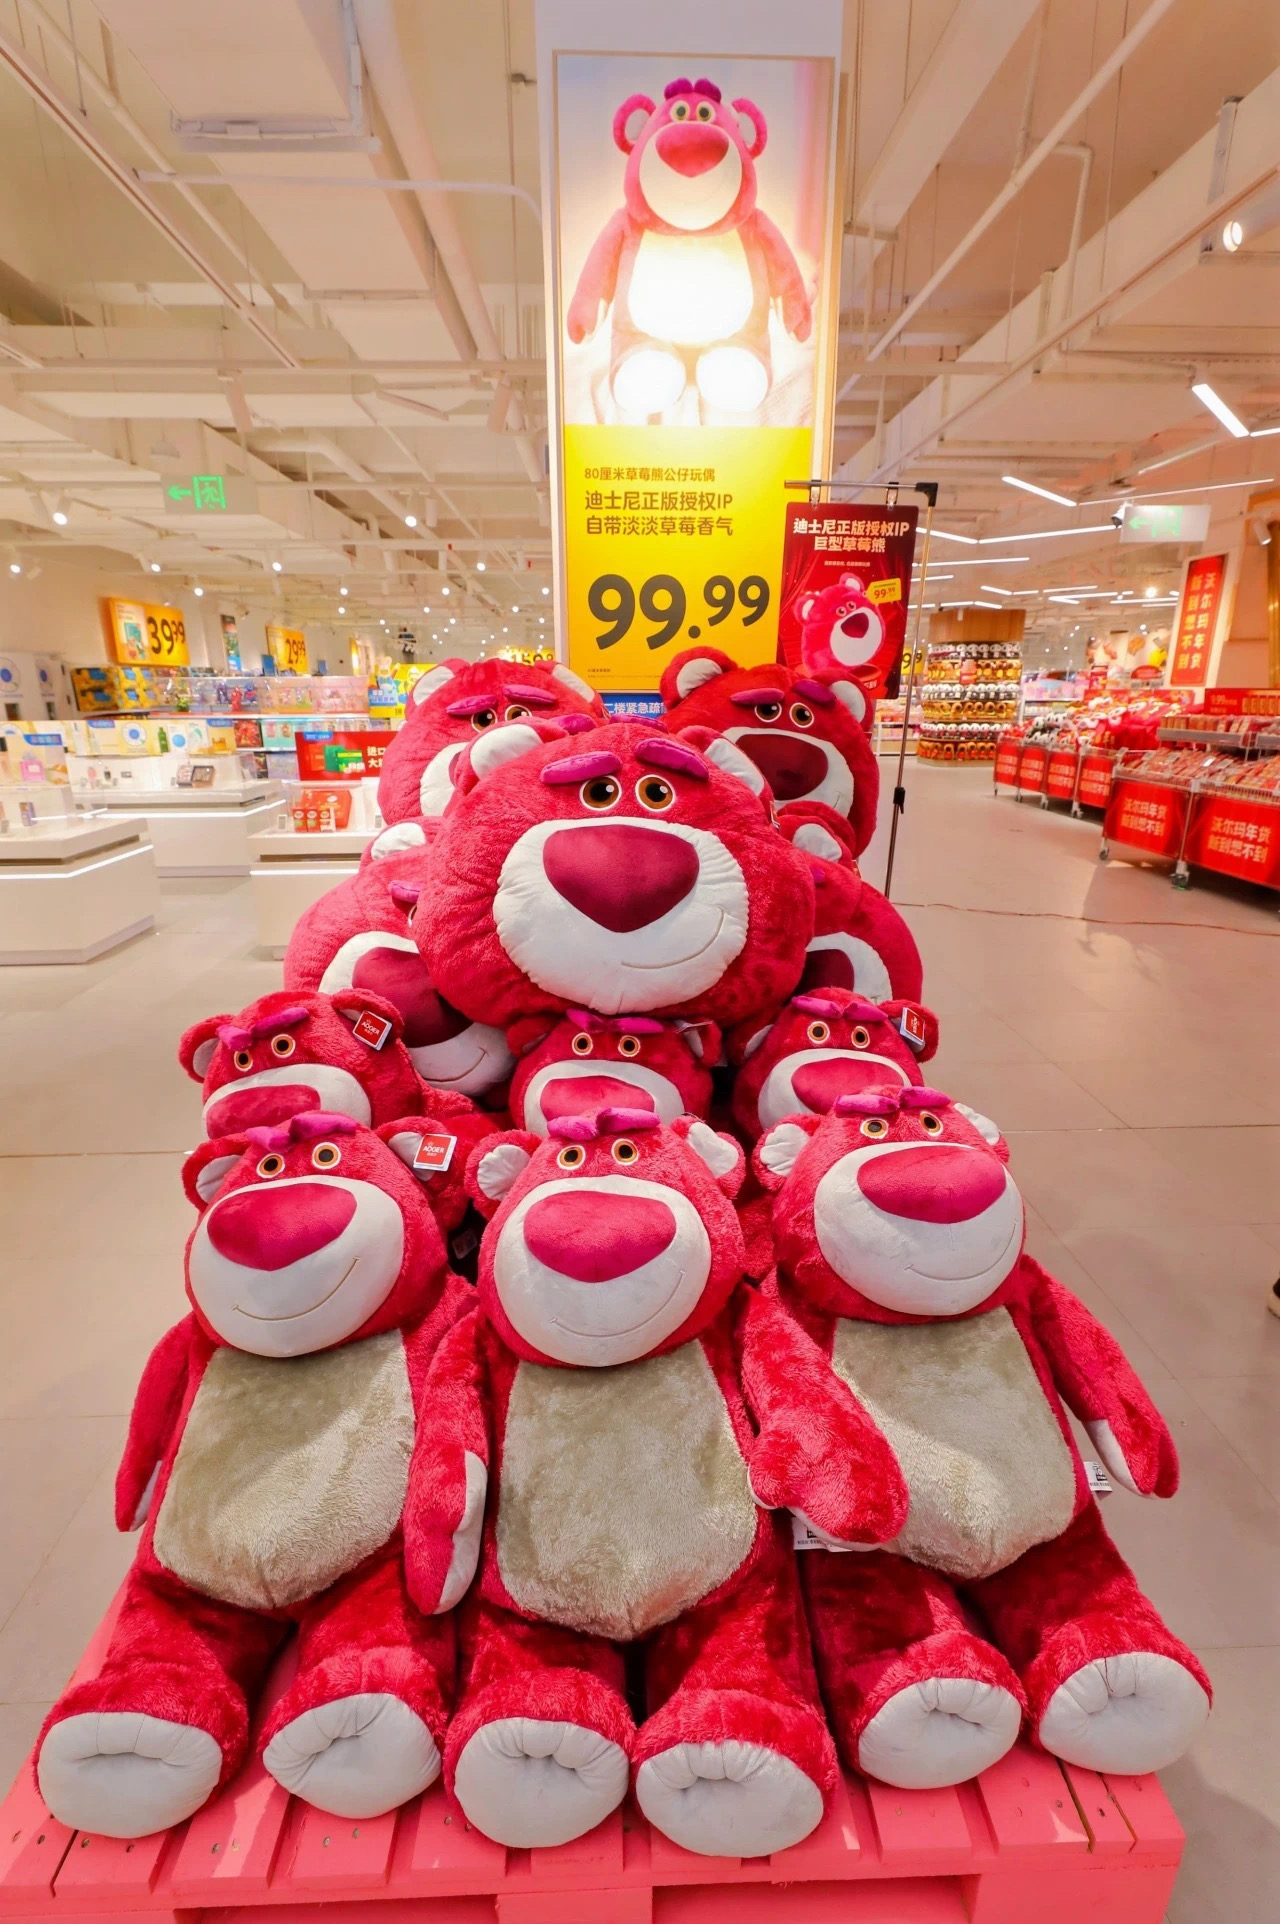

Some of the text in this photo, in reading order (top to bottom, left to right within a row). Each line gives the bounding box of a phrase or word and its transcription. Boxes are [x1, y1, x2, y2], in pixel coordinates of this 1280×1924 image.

[584, 467, 715, 482] 80厘米草莓熊公仔玩偶
[585, 490, 733, 511] 迪士尼正版授权IP
[586, 515, 733, 536] 自带淡淡草莓香气
[793, 517, 910, 537] 迪士尼正版授权IP
[814, 536, 886, 553] 巨型草莓熊
[1123, 798, 1168, 820] 沃尔玛年货
[1212, 815, 1272, 843] 沃尔玛年货
